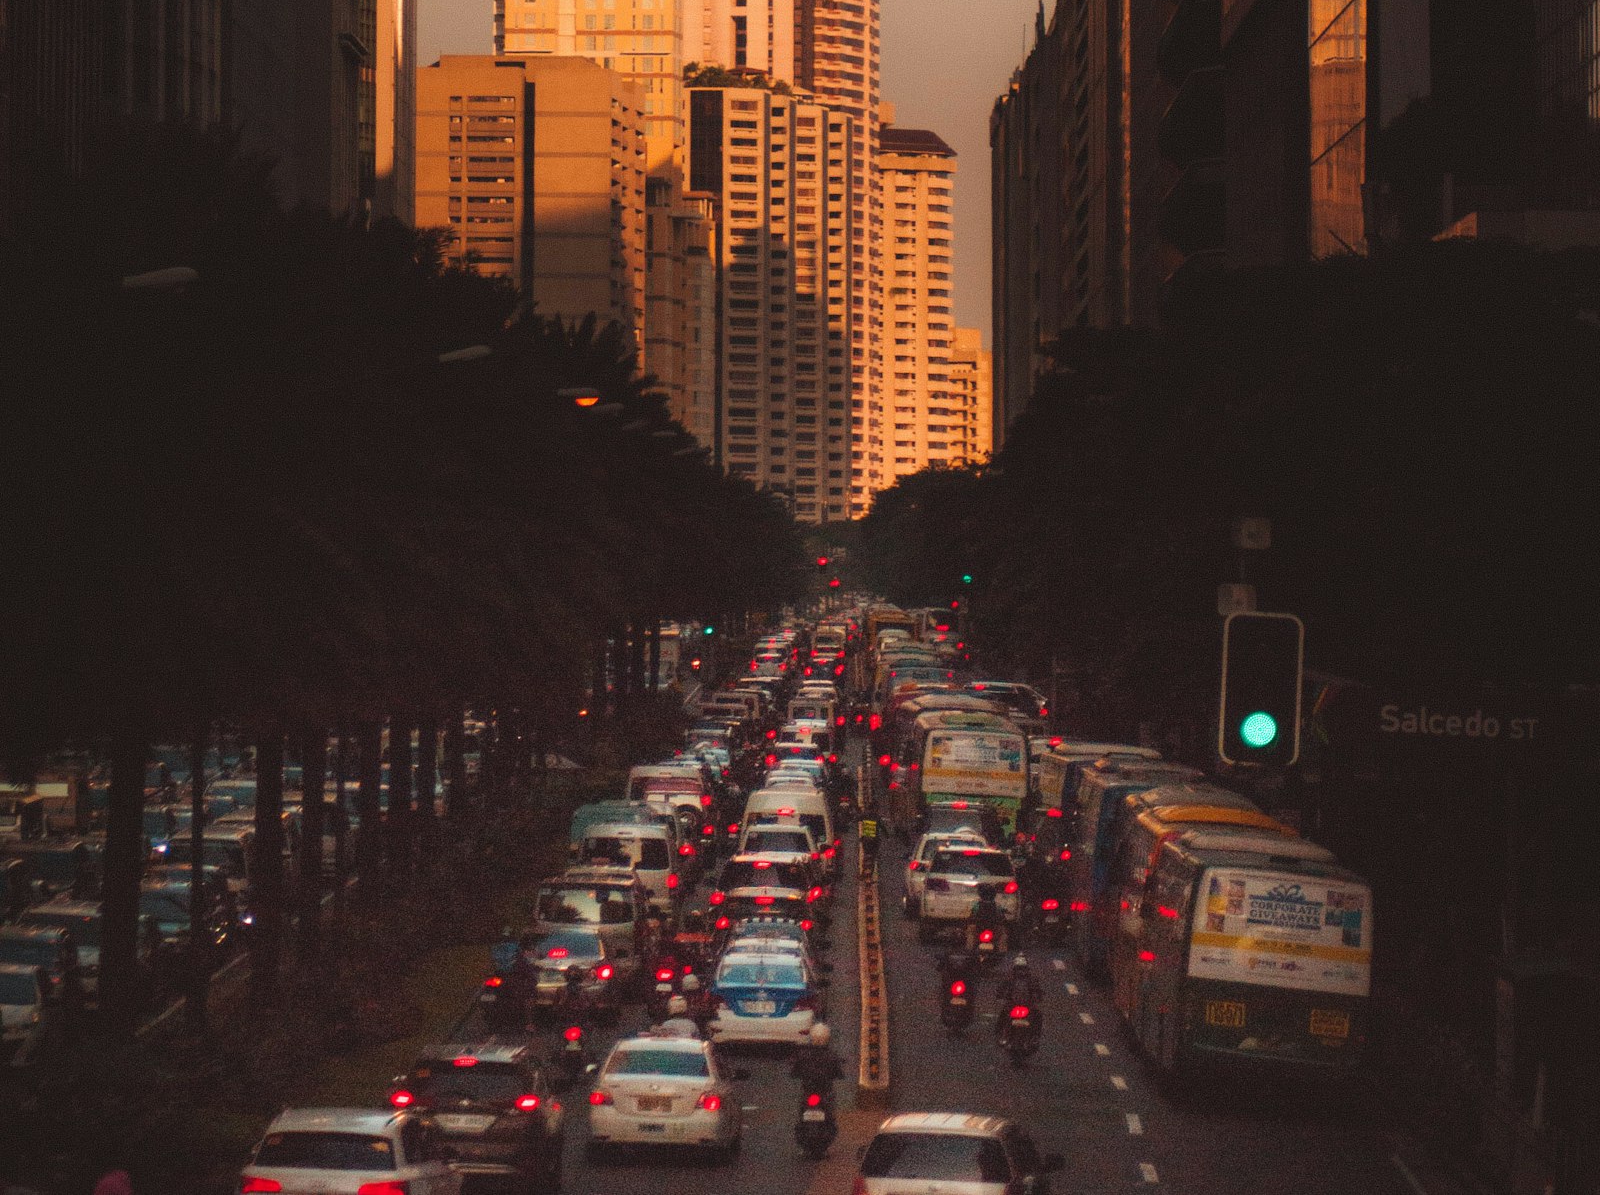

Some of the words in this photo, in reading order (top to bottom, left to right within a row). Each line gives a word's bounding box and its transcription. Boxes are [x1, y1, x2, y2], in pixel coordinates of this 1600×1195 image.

[1379, 703, 1501, 739] Salcedo
[1509, 718, 1539, 740] ST
[1250, 900, 1321, 917] CORPORATE
[1249, 909, 1321, 926] GIVEAWAYS
